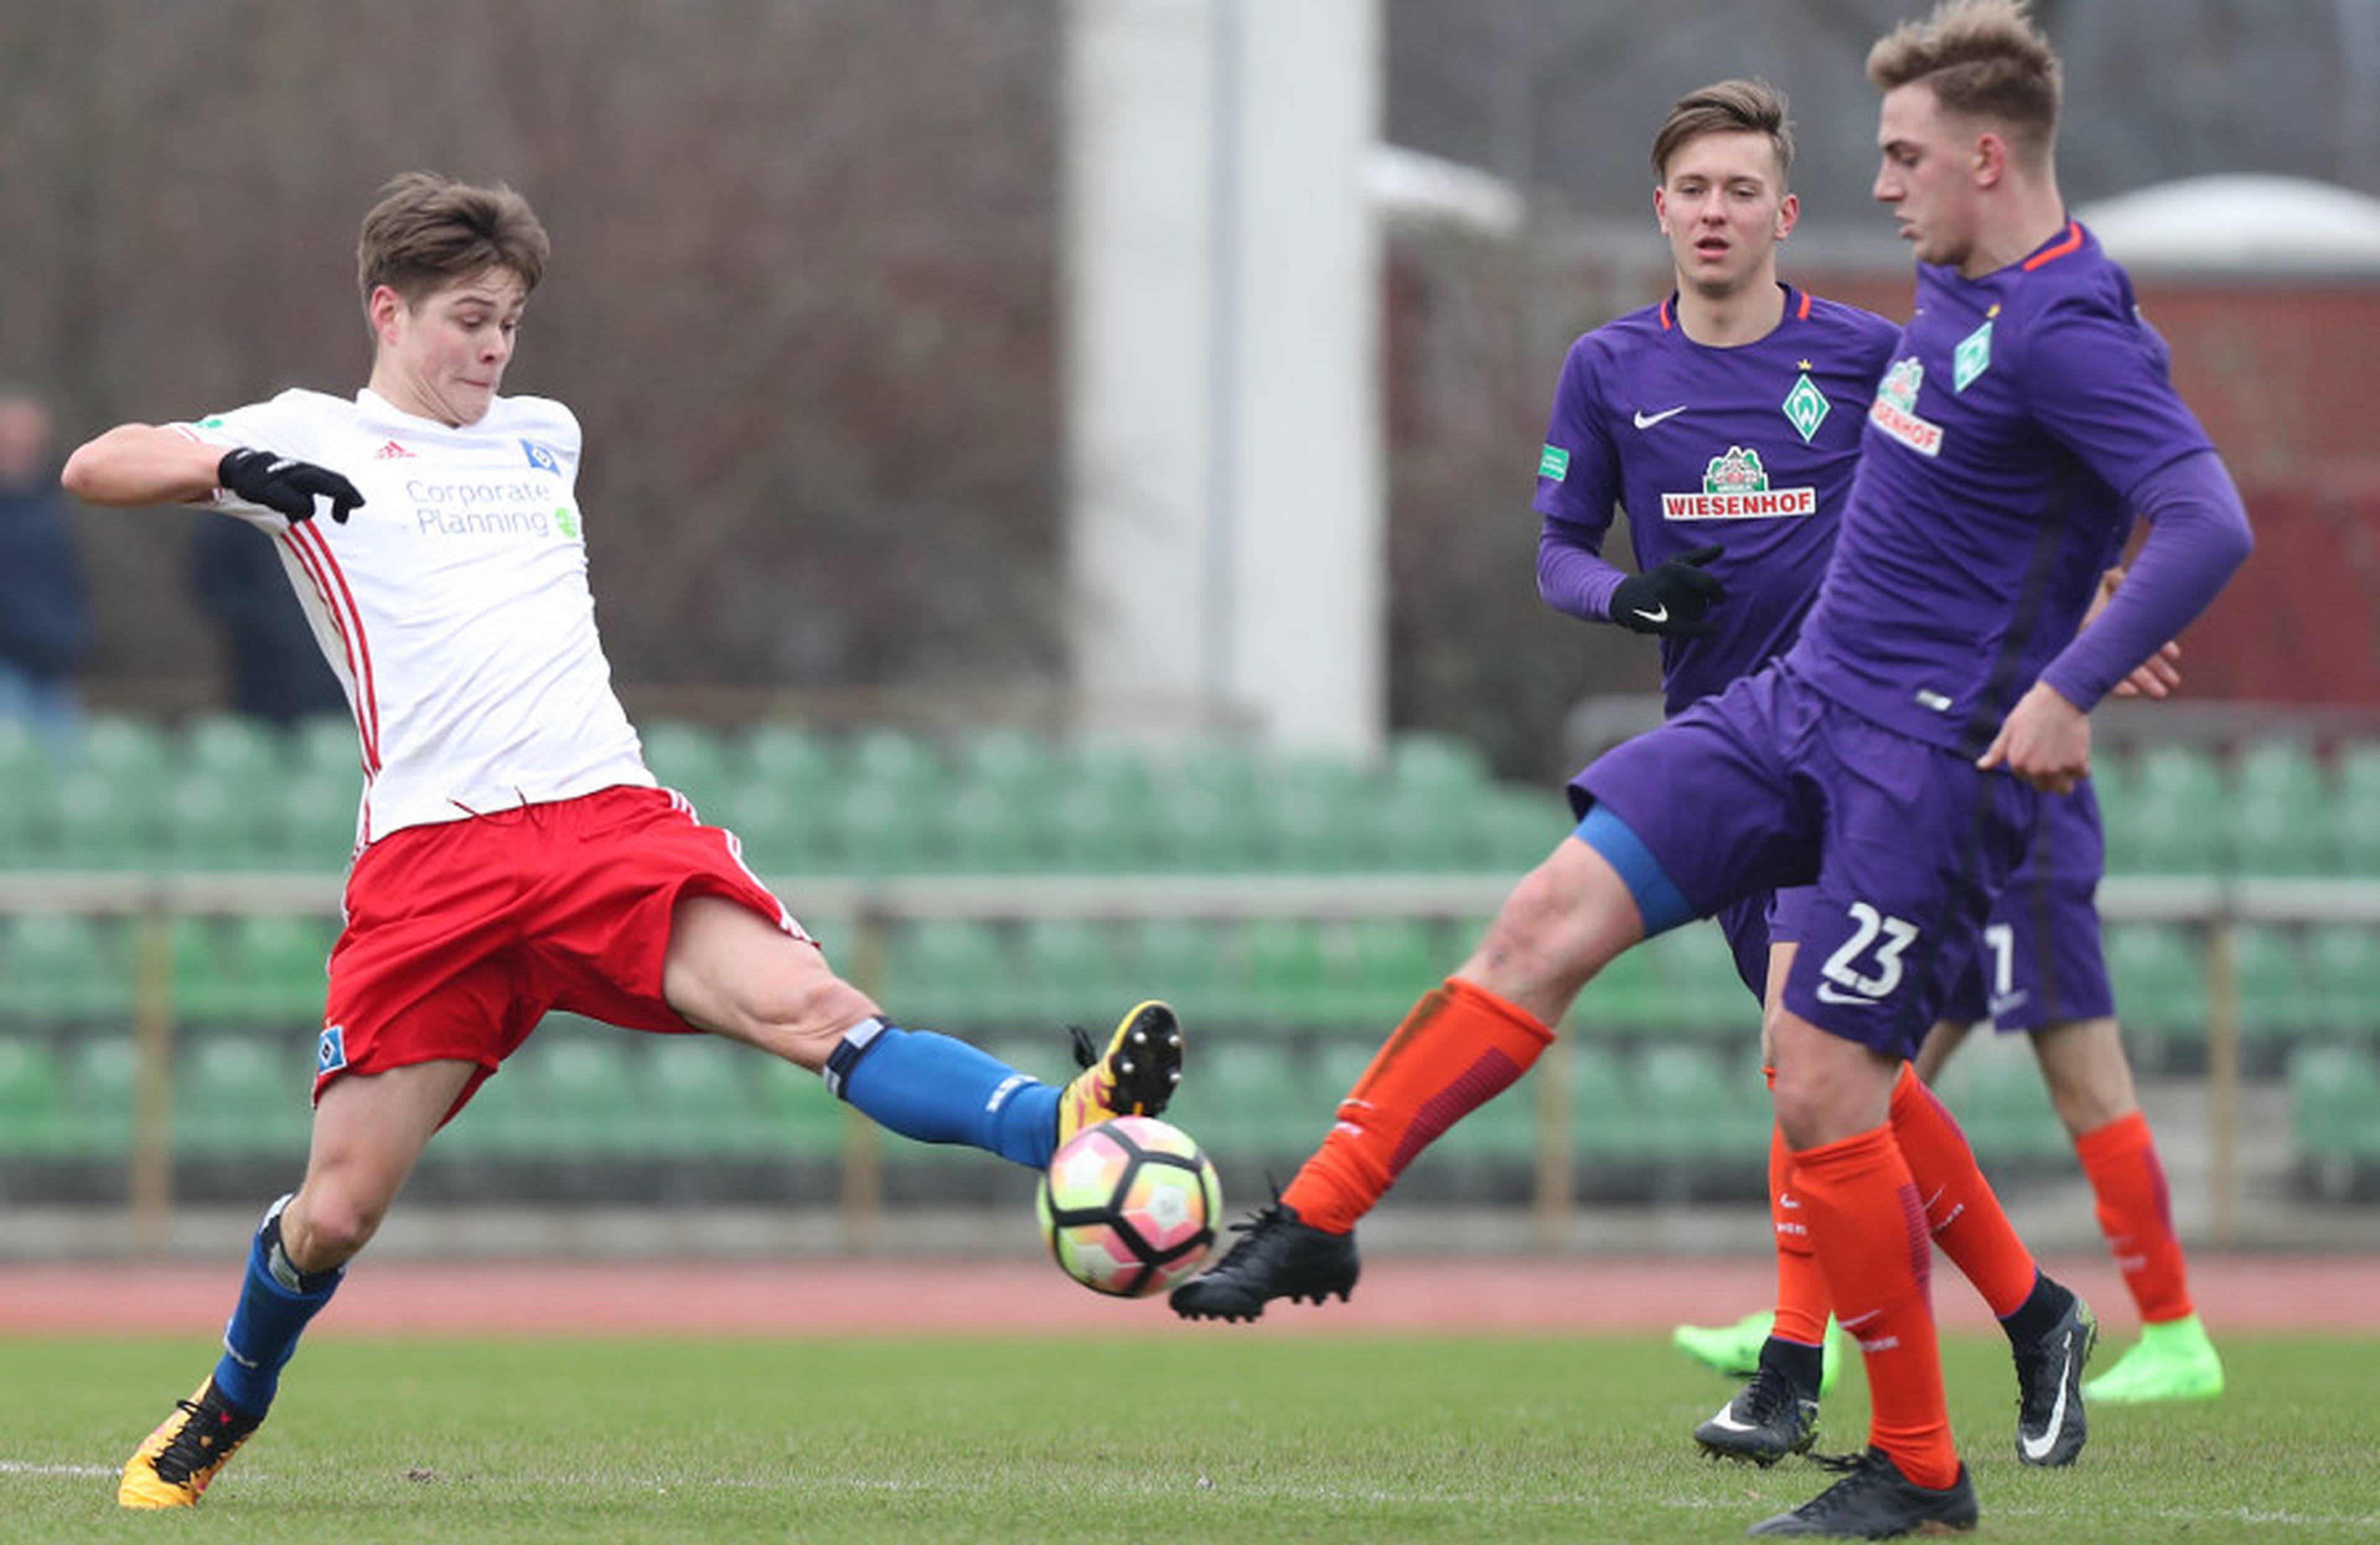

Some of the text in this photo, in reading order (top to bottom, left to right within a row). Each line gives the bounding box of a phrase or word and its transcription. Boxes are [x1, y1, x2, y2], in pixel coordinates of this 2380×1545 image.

[406, 480, 550, 506] Corporate
[1666, 492, 1811, 516] WIESENHOF
[416, 508, 550, 537] Planning
[1820, 901, 1920, 998] 23
